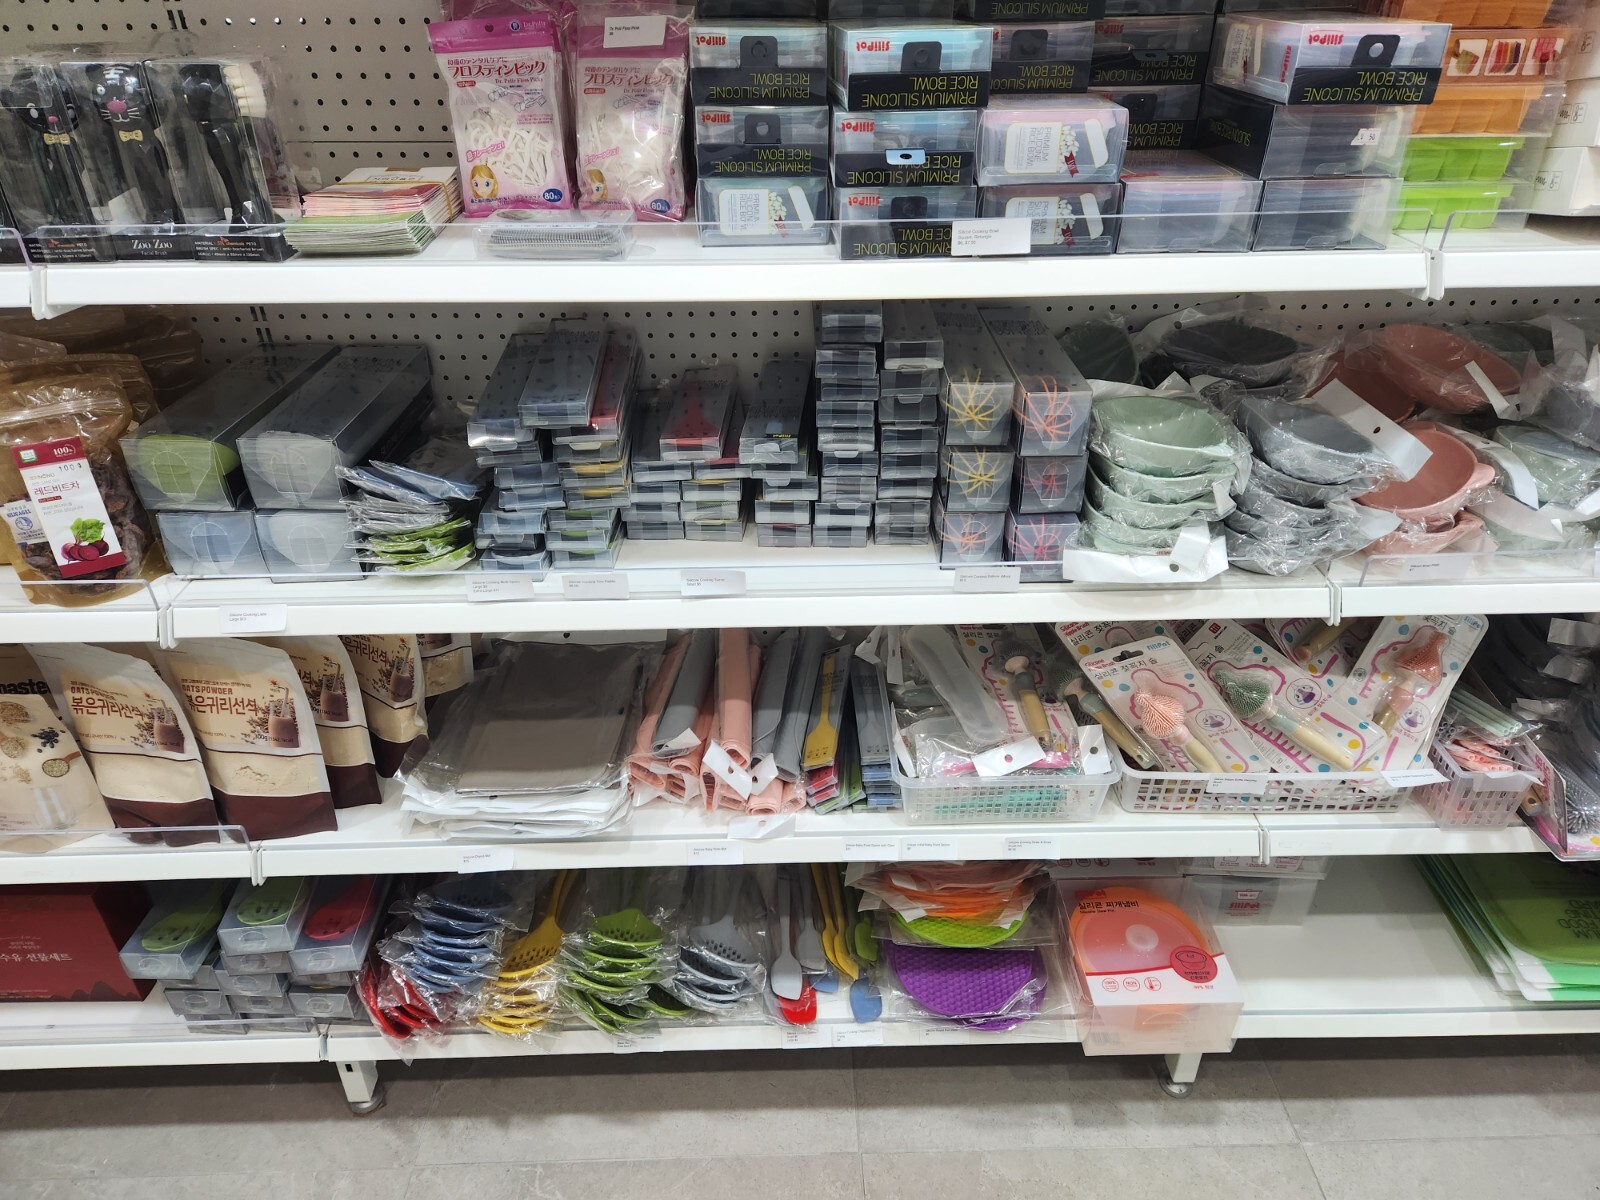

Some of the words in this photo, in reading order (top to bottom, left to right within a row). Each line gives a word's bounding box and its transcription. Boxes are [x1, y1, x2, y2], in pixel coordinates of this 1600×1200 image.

[1018, 65, 1049, 77] BOWL
[1051, 65, 1075, 76] RICE
[750, 73, 783, 85] BOWL
[785, 73, 810, 85] RICE
[909, 76, 947, 91] BOWL
[950, 76, 979, 90] RICE
[989, 78, 1026, 90] SILICO
[1025, 77, 1073, 89] PRIMIUM
[1356, 71, 1395, 86] BOWL
[1395, 72, 1428, 86] RICE
[709, 86, 760, 99] SILICONE
[761, 86, 810, 98] PRIMIUM
[921, 91, 977, 105] PRIMIUM
[1301, 87, 1363, 102] SILICONE
[1364, 87, 1424, 102] PRIMIUM
[861, 93, 919, 107] SILICONE
[1158, 123, 1184, 134] RICE
[753, 149, 785, 160] BOWL
[787, 148, 812, 160] RICE
[714, 161, 763, 173] SILICONE
[765, 161, 812, 172] PRIMIUM
[934, 155, 961, 168] RICE
[847, 171, 903, 184] SILICONE
[906, 170, 960, 183] PRIMIUM
[898, 228, 933, 241] BOWL
[132, 239, 151, 250] Zoo
[153, 239, 173, 249] Zoo
[853, 242, 906, 255] SILICONE
[910, 242, 952, 255] RIMIUM
[34, 481, 80, 496] 레드비트차
[71, 686, 90, 695] OATS
[202, 686, 234, 696] POWDER
[1079, 901, 1103, 910] 실리콘
